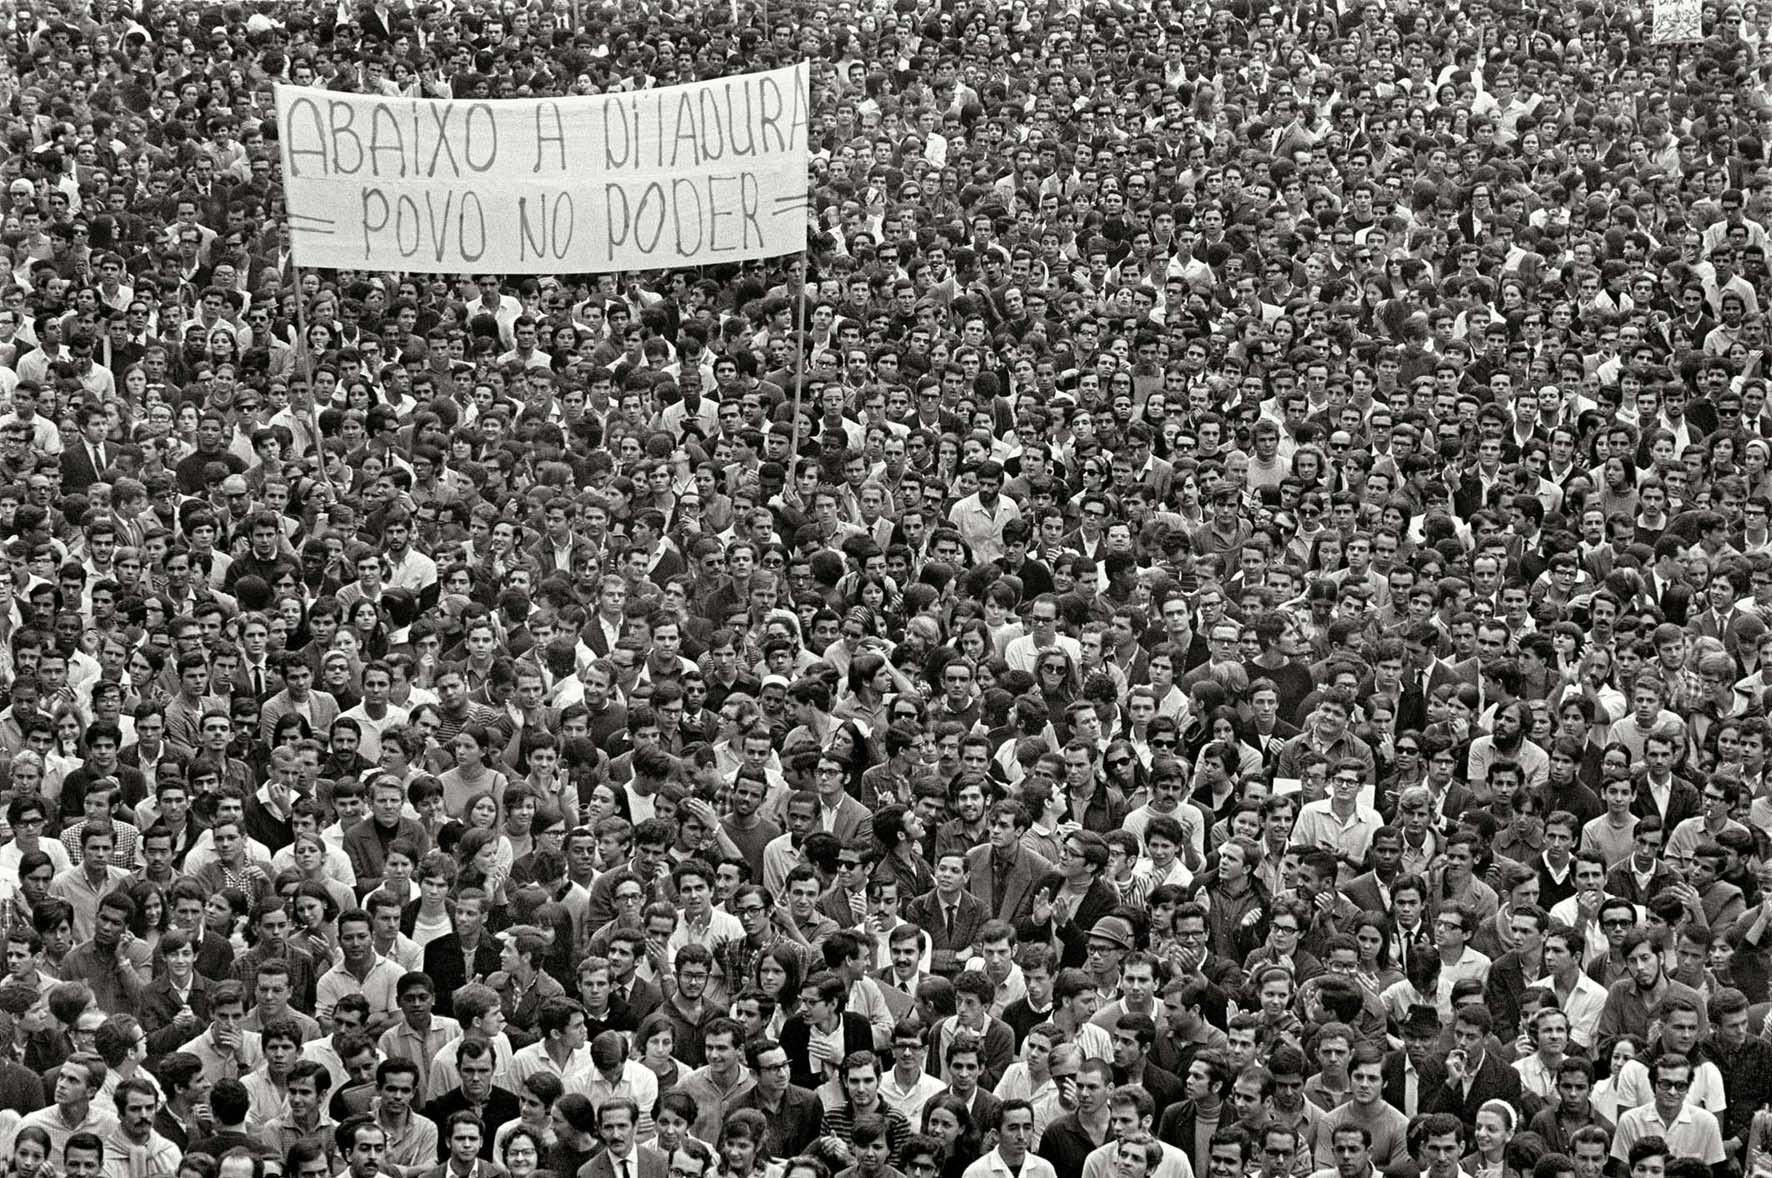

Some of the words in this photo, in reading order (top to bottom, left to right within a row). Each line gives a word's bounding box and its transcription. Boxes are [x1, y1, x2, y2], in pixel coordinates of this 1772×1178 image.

[532, 102, 567, 174] A
[360, 185, 487, 263] POVO
[517, 190, 574, 263] NO
[604, 171, 765, 263] PODER
